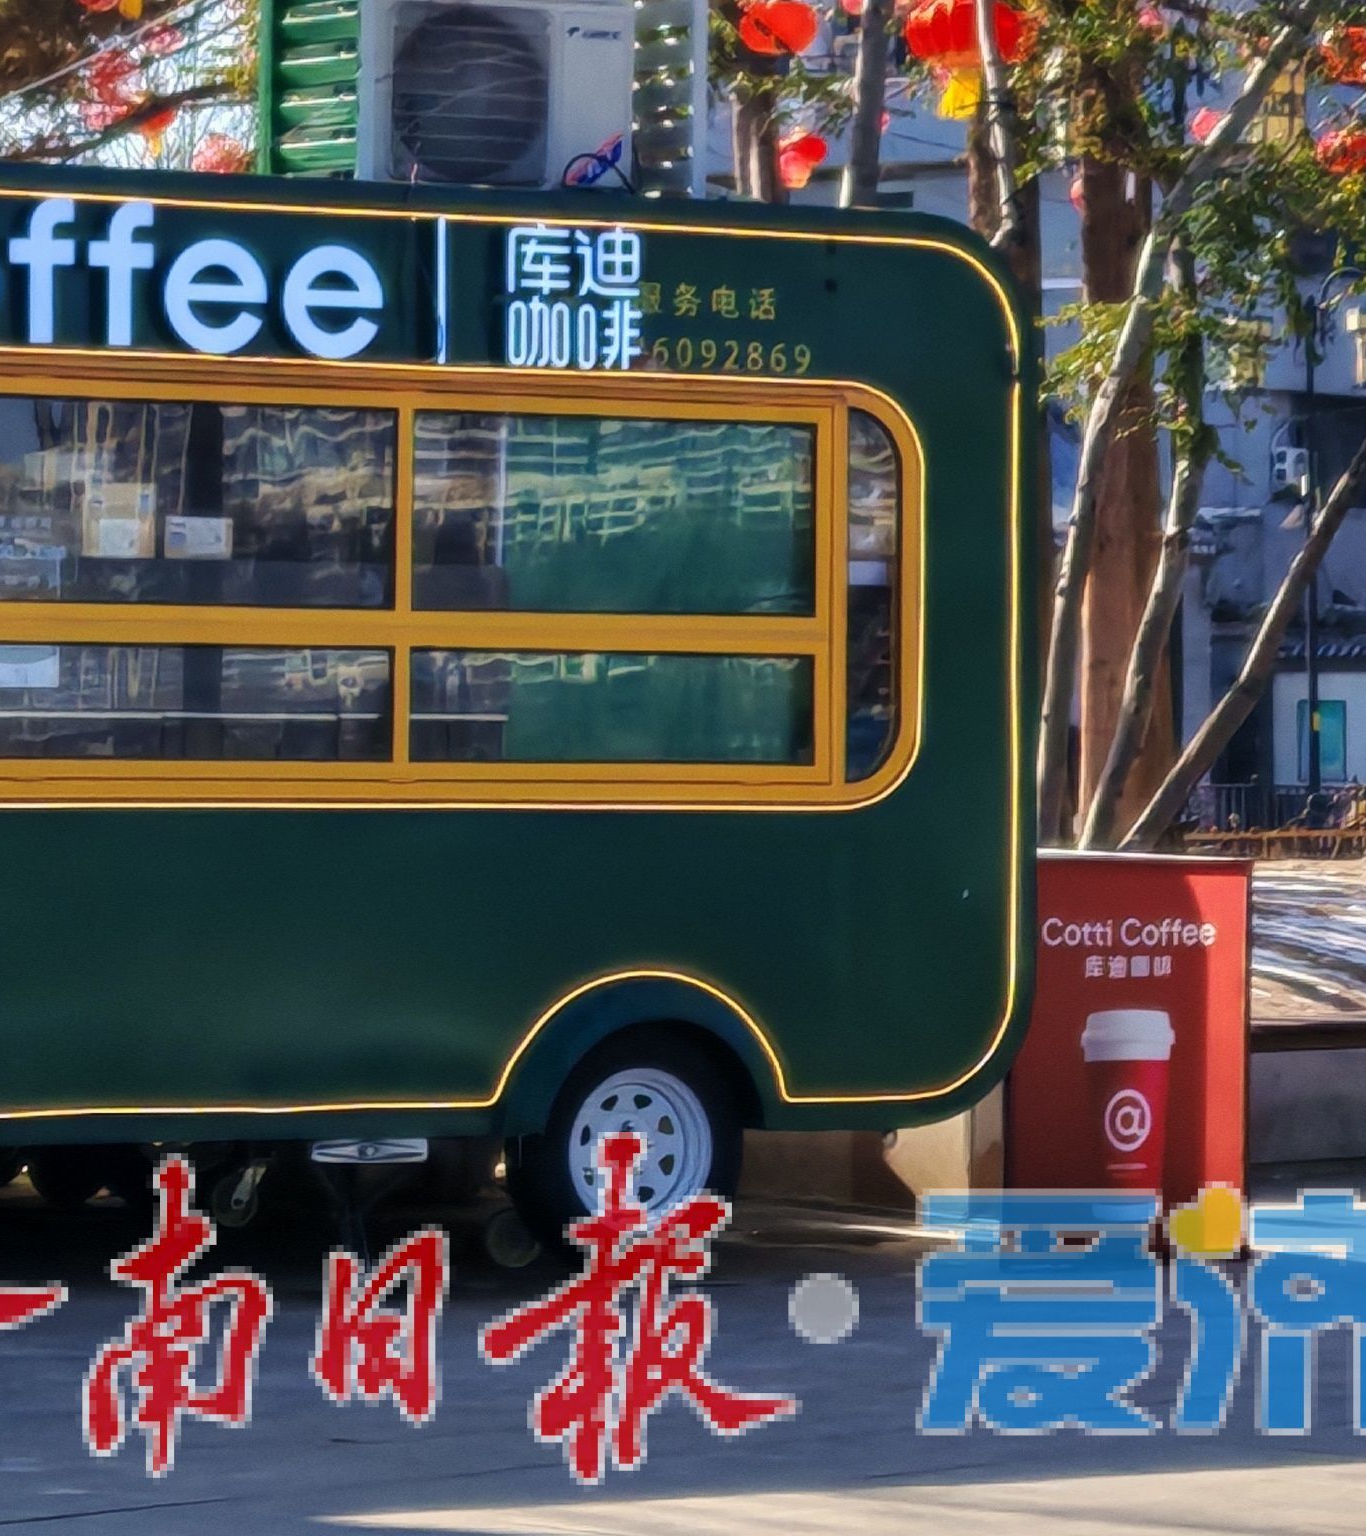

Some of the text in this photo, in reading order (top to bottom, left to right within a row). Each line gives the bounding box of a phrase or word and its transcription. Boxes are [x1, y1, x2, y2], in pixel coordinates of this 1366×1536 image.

[506, 223, 642, 297] 库迪
[506, 299, 642, 371] 咖啡
[638, 337, 812, 375] 6092869
[1042, 917, 1217, 947] Cotti Coffee
